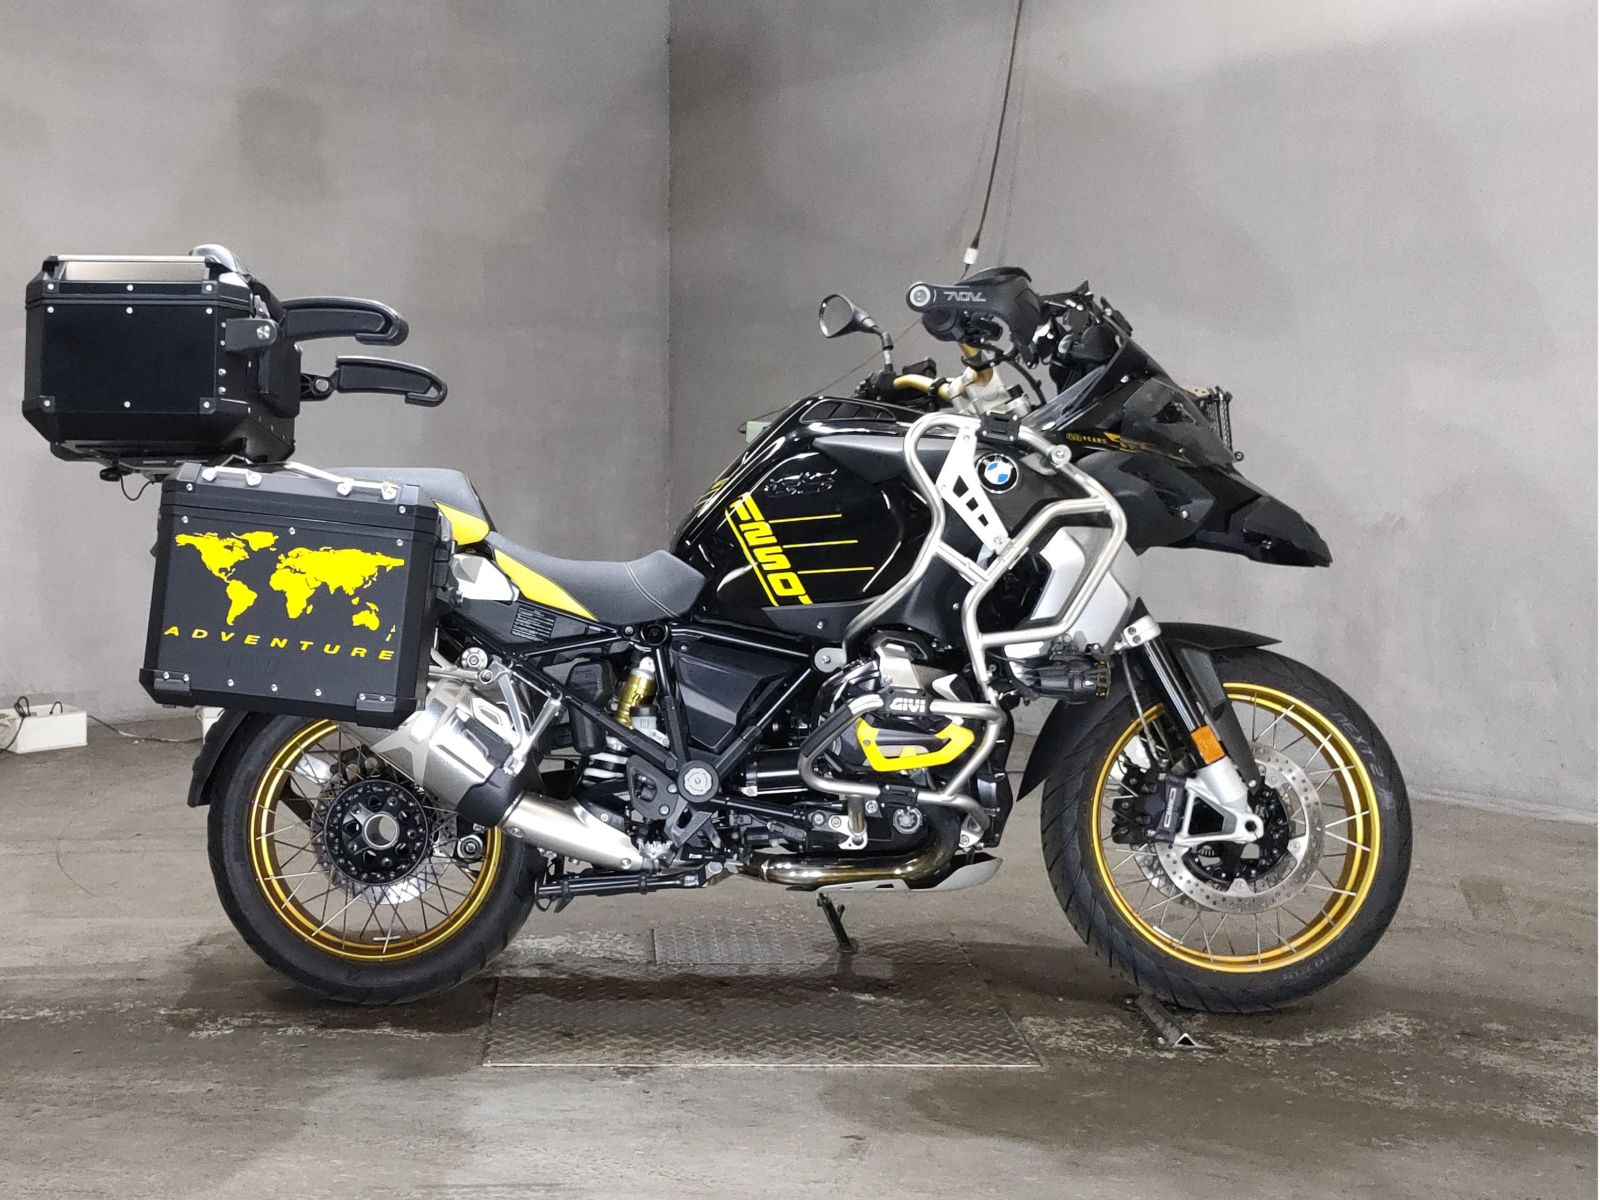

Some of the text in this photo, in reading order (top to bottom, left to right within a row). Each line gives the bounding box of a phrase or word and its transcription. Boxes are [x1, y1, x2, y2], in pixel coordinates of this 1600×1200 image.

[1082, 434, 1108, 445] YEARS
[164, 626, 394, 660] ADVENTURE
[889, 697, 926, 713] GIVI
